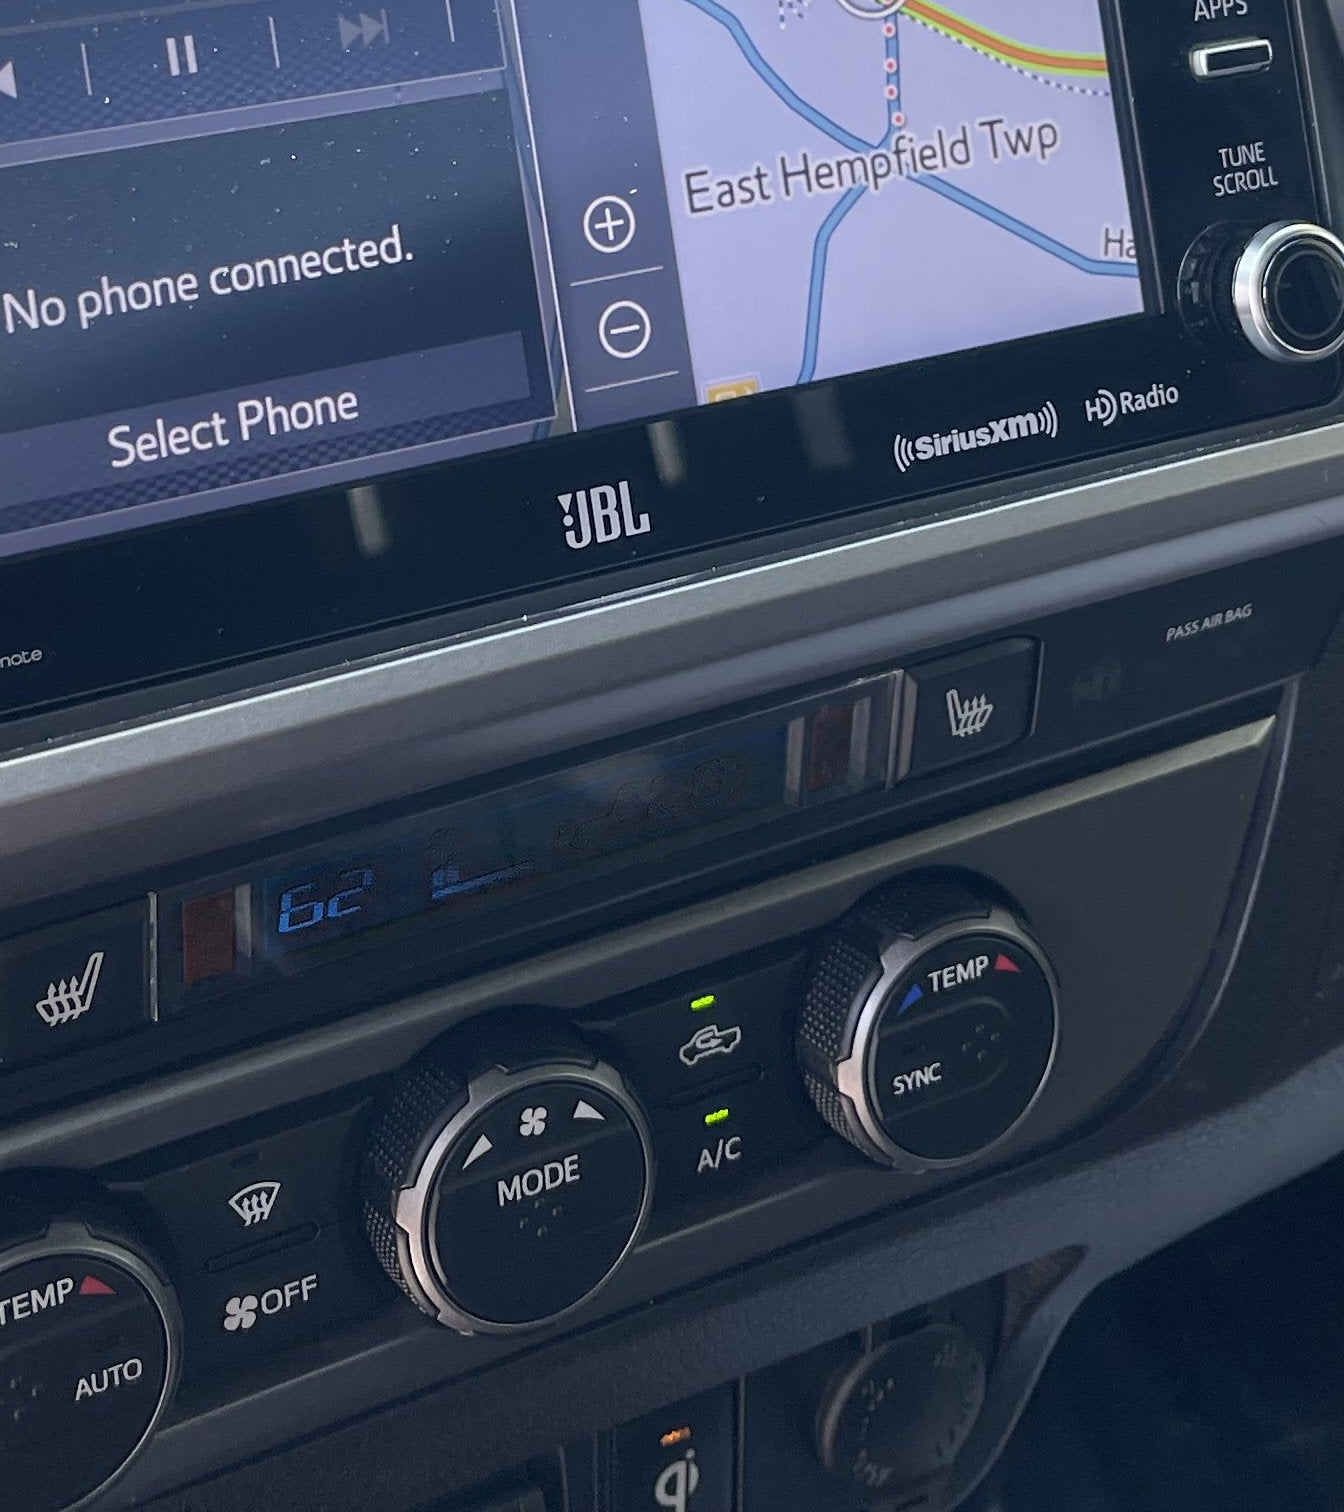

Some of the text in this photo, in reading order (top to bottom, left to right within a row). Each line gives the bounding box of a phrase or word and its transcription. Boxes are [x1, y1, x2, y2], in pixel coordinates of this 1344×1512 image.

[684, 116, 1060, 216] East Hempfield Twp
[1217, 141, 1267, 168] TUNE
[1213, 163, 1280, 197] SCROLL
[2, 223, 415, 334] No phone connected.
[1120, 383, 1179, 415] Radio
[106, 391, 360, 470] Select Phone
[557, 480, 652, 551] JBL
[1166, 603, 1253, 642] PASS AIR BAG
[927, 954, 989, 993] TEMP
[891, 1061, 943, 1096] SYNC
[697, 1135, 742, 1173] A/C
[497, 1154, 582, 1207] MODE
[260, 1273, 319, 1317] OFF
[74, 1356, 145, 1402] AUTO
